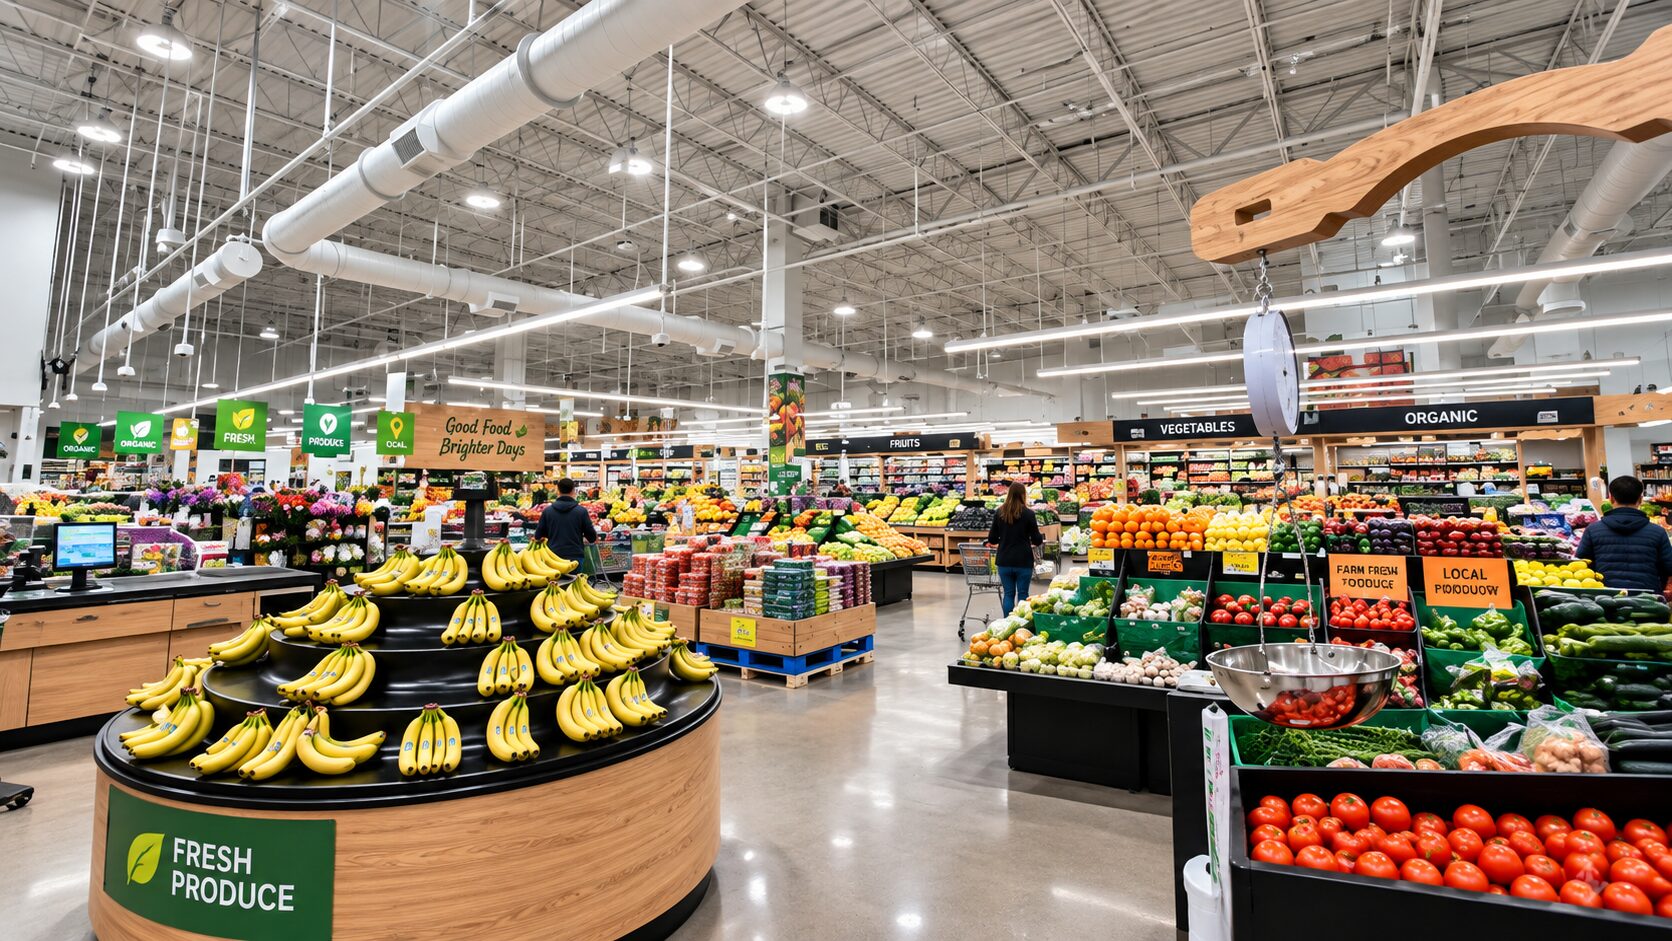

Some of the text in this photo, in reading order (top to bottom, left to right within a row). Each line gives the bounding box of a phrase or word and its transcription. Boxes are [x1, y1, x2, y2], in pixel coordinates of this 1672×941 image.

[1405, 409, 1478, 424] ORGANIC
[445, 416, 512, 435] Good Food
[1160, 421, 1236, 435] VEGETABLES
[120, 440, 157, 449] ORGANIC
[308, 437, 344, 447] PRODUCE
[889, 438, 920, 448] FRUITS
[63, 445, 96, 453] ORGANIC
[439, 437, 525, 462] Brighter Days
[1336, 565, 1365, 575] FARM
[1443, 567, 1488, 580] LOCAL
[173, 837, 252, 874] FRESH
[171, 870, 295, 912] PRODUCE
